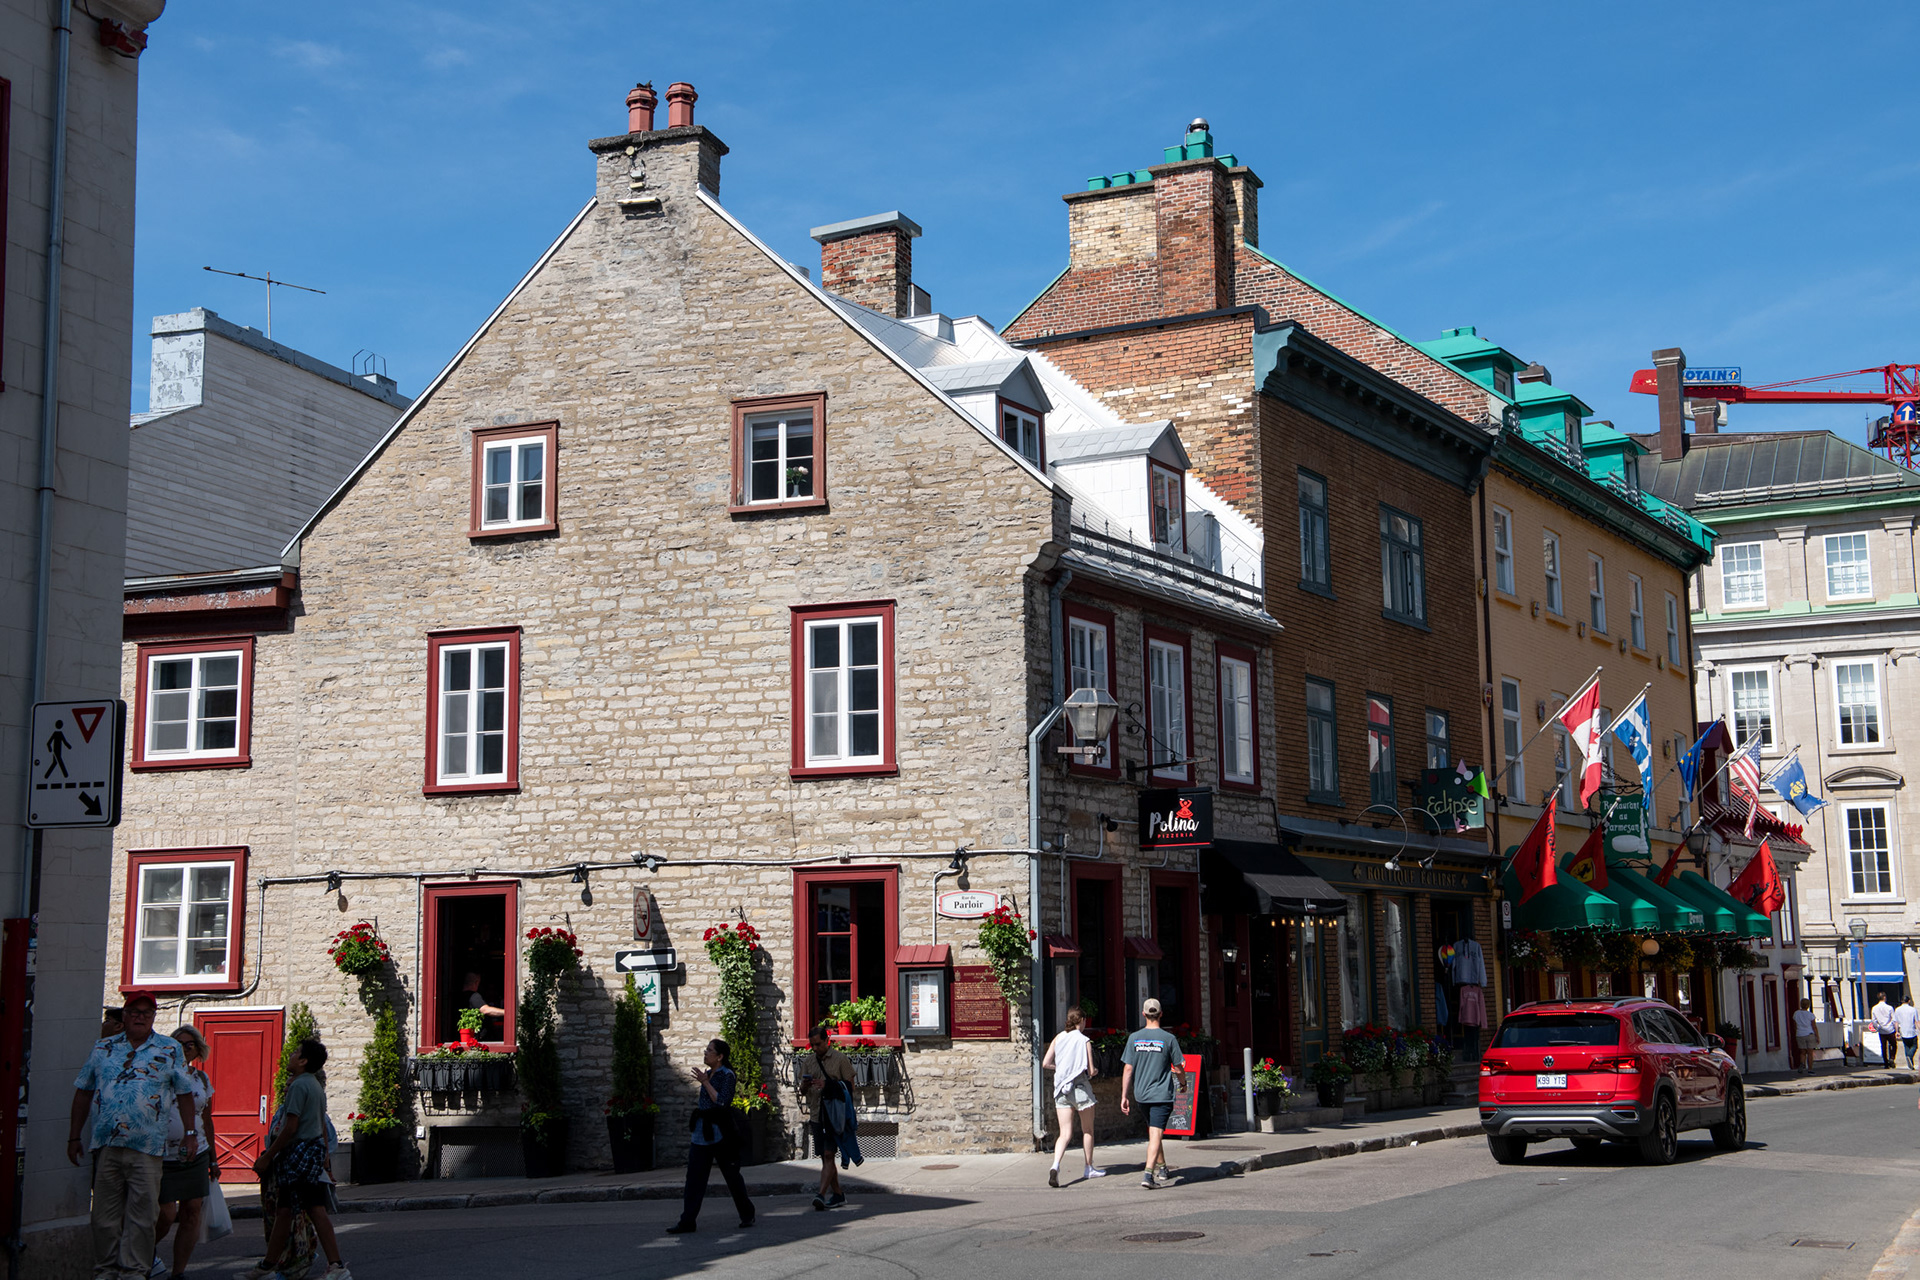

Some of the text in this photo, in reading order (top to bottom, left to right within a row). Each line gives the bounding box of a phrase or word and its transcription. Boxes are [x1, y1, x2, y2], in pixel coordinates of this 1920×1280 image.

[1682, 370, 1727, 380] OTAIN
[1427, 790, 1478, 820] Eclipse
[1602, 800, 1640, 810] Reaurant
[1149, 810, 1199, 839] Polina
[1609, 824, 1640, 833] armesan
[1367, 866, 1415, 885] BOUTIQUE
[954, 900, 984, 909] Parloir
[1537, 1076, 1566, 1085] K99 YTS
